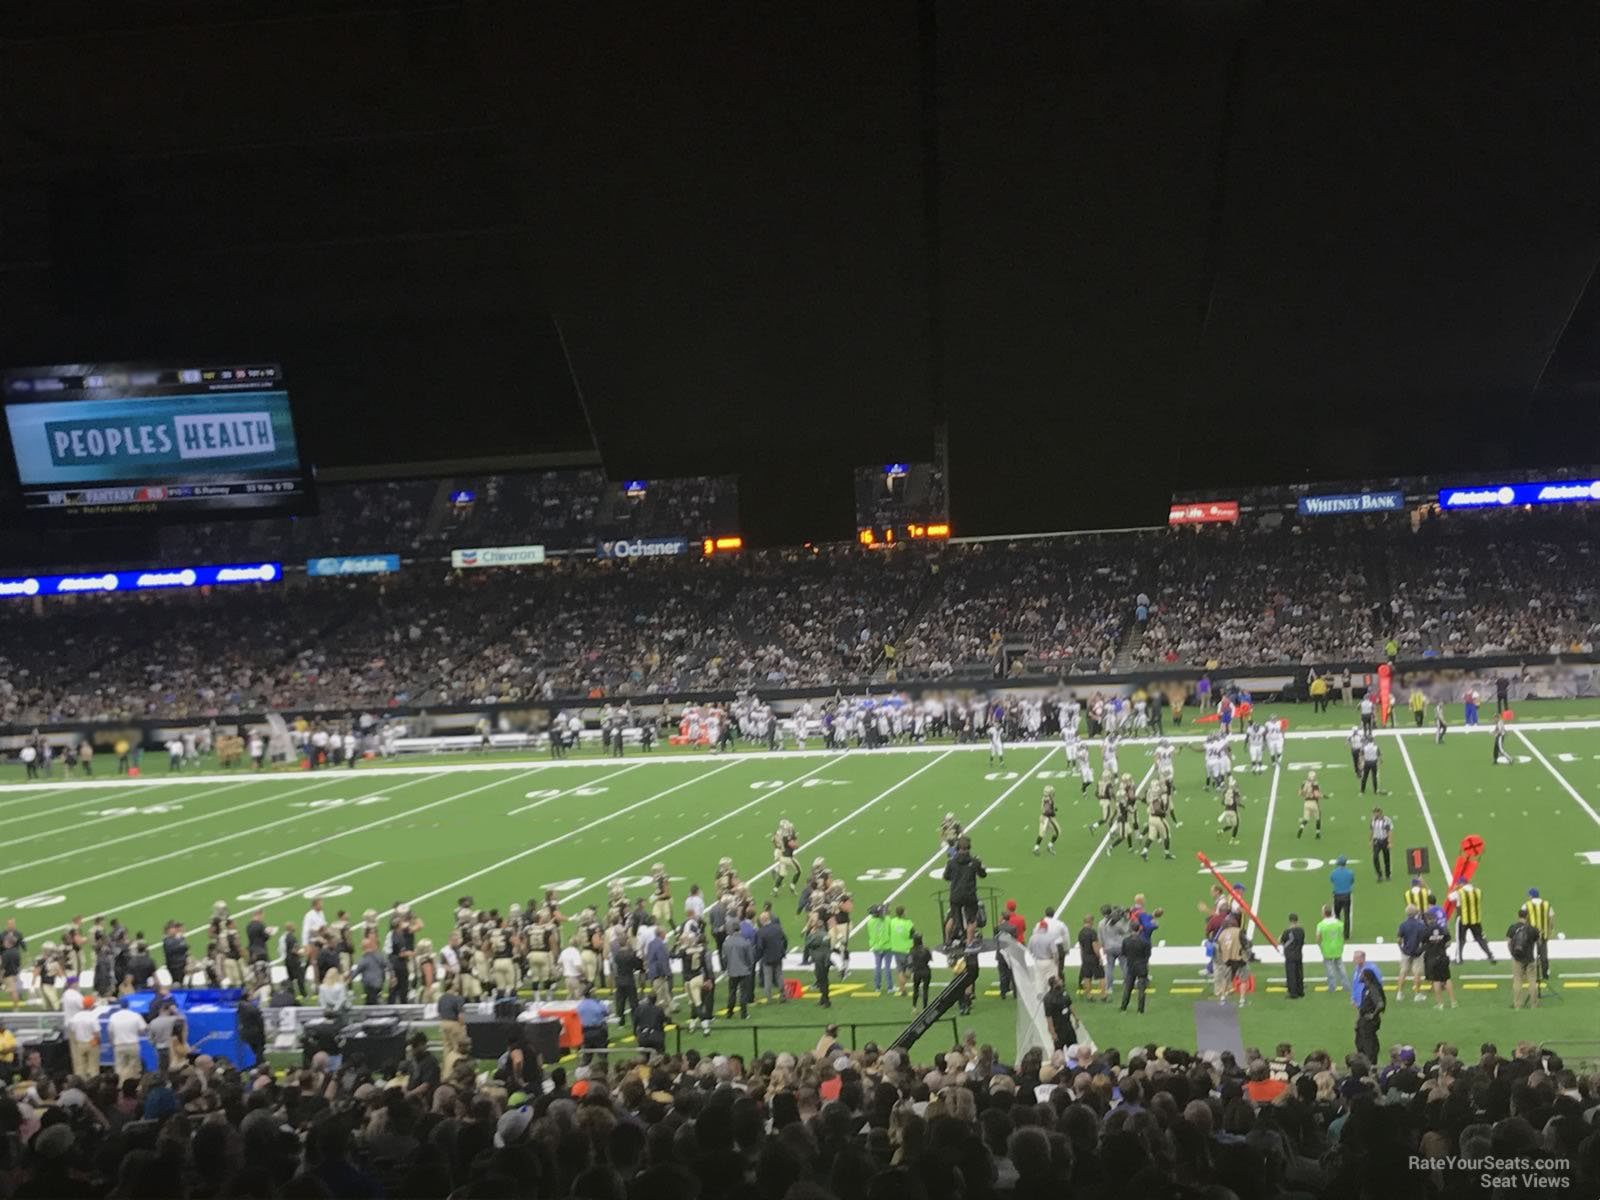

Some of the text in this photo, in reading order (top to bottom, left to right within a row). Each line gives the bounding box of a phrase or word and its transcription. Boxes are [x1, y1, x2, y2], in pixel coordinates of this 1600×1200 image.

[54, 421, 271, 458] PEOPLES HEALTH
[1305, 495, 1396, 513] WHITNEY BANK
[482, 549, 536, 563] Chevron
[614, 540, 682, 558] Ochsner
[1197, 858, 1325, 874] 20
[1412, 848, 1422, 869] 1
